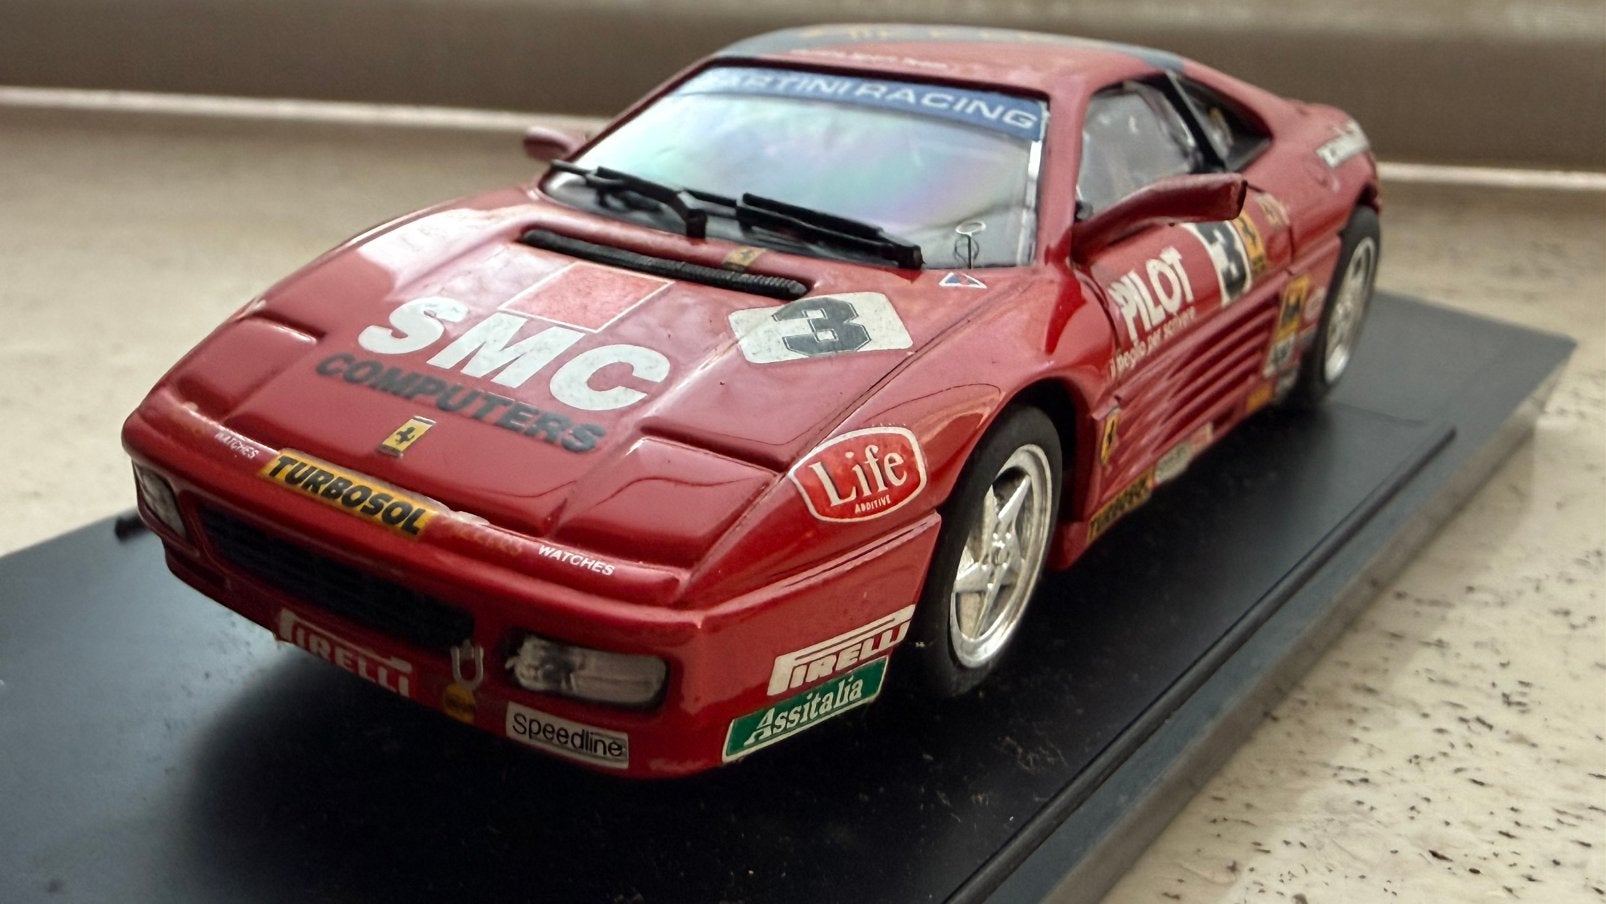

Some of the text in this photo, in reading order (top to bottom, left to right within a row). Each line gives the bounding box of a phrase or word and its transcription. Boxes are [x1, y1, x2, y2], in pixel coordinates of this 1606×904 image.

[854, 83, 1039, 129] RACING
[771, 296, 874, 357] 3
[1107, 246, 1194, 347] PILOT
[357, 297, 671, 411] SMC
[316, 352, 607, 454] COMPUTERS
[265, 454, 431, 536] TURBOSOL
[809, 444, 908, 507] Life
[854, 496, 892, 515] ADDITIVE
[538, 544, 616, 577] WATCHES
[278, 607, 413, 698] PIRELLI
[767, 604, 916, 697] PIRELLI
[511, 712, 623, 758] Speedline
[743, 675, 864, 748] Assitalia
